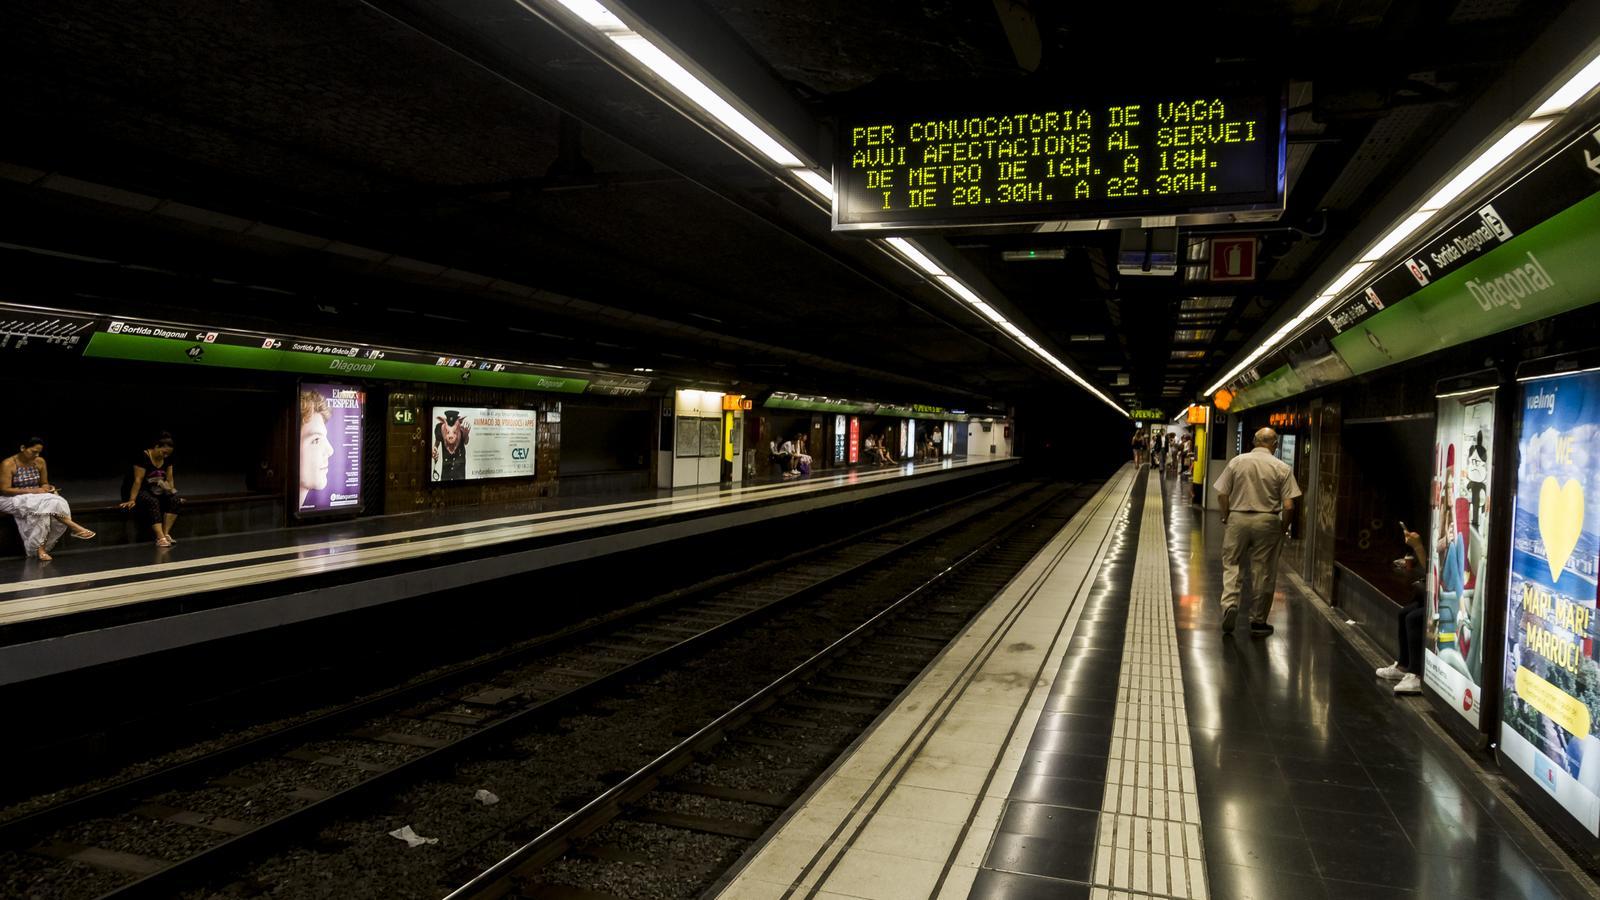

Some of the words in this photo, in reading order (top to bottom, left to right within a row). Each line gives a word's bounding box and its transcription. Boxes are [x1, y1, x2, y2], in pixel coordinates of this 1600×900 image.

[852, 124, 894, 147] PER
[1108, 105, 1141, 127] DE
[1157, 98, 1225, 123] VAGA
[852, 146, 906, 168] AVUI
[924, 133, 1091, 164] AFECTACIONS
[1107, 130, 1139, 151] AL
[1156, 121, 1256, 147] SERVEI
[866, 169, 894, 189] DE
[909, 163, 981, 186] METRO
[998, 160, 1028, 180] DE
[1046, 156, 1101, 178] 16H.
[1123, 153, 1139, 173] A
[1159, 149, 1217, 171] 18H.
[882, 191, 892, 210] I
[908, 188, 937, 208] DE
[952, 182, 1053, 206] 20.30H.
[1074, 179, 1090, 199] A
[1430, 241, 1461, 269] Sortida
[1454, 219, 1496, 255] Diagonal
[1464, 250, 1555, 312] Diagonal
[121, 324, 152, 336] Sortida
[153, 328, 188, 339] Diagonal
[329, 359, 376, 373] Diagonal
[511, 447, 530, 460] CEV
[1555, 595, 1590, 639] MAR!
[1526, 620, 1580, 675] MARROC!
